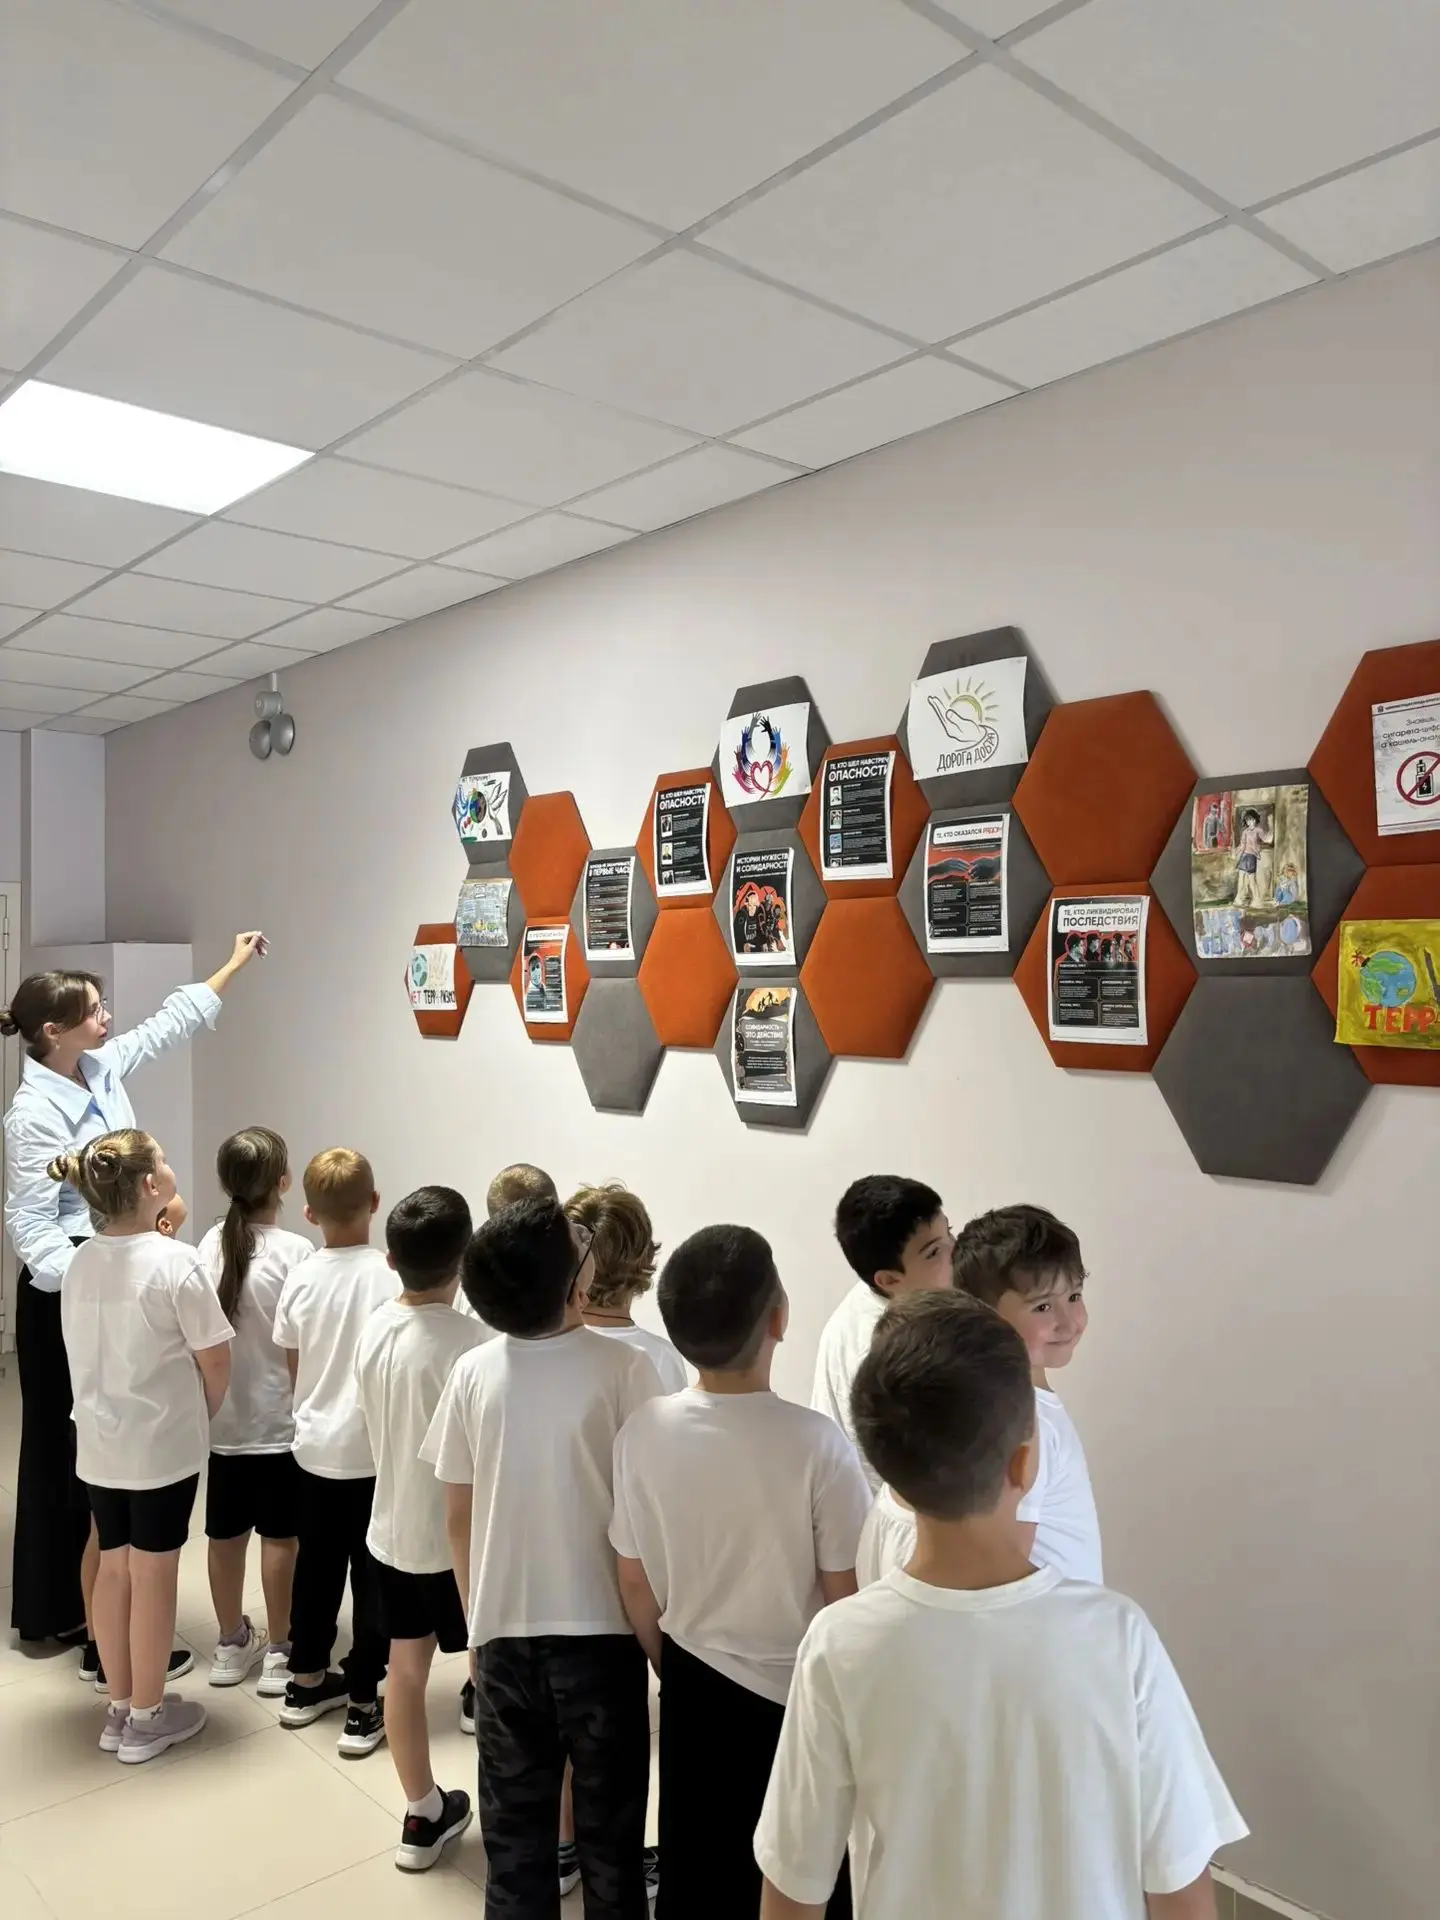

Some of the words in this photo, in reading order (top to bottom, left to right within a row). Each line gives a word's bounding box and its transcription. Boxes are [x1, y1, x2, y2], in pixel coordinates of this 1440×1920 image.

[936, 751, 972, 773] ДОРОГА
[974, 732, 996, 763] ДОБРА
[954, 828, 982, 836] ОКАЗАЛСЯ
[1086, 907, 1139, 915] ЛИКВИДИРОВАЛ
[1063, 916, 1138, 927] ПОСЛЕДСТВИЯ
